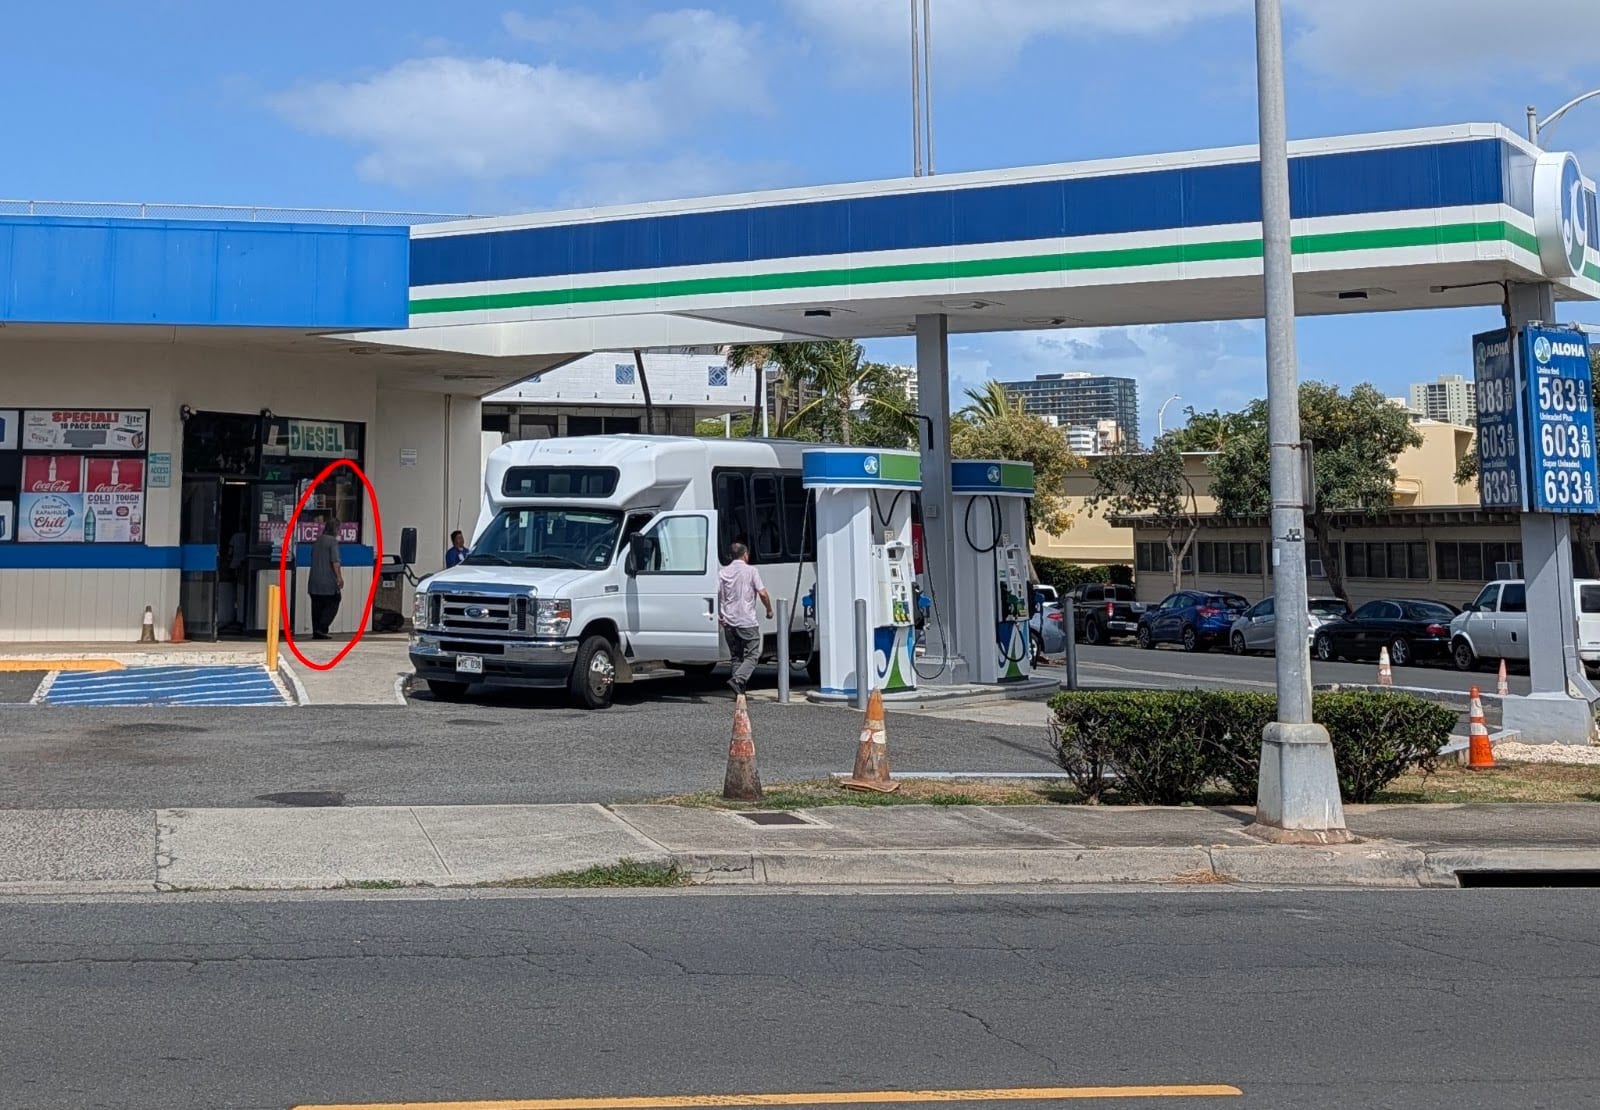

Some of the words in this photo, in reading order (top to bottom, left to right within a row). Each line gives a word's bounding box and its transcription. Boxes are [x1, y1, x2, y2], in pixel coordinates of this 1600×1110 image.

[1552, 342, 1585, 357] ALOHA
[1478, 379, 1504, 413] 583
[1538, 376, 1577, 412] 583
[52, 411, 120, 423] SPECIAL!
[1540, 413, 1562, 421] Unleaded
[290, 425, 343, 452] DIESEL
[1481, 424, 1506, 459] 603
[1541, 423, 1580, 458] 603
[1542, 459, 1556, 469] Super
[1557, 460, 1580, 468] Unleaded
[1483, 470, 1509, 504] 633
[1544, 470, 1583, 504] 633
[34, 516, 67, 528] Chill
[302, 527, 318, 541] ICE
